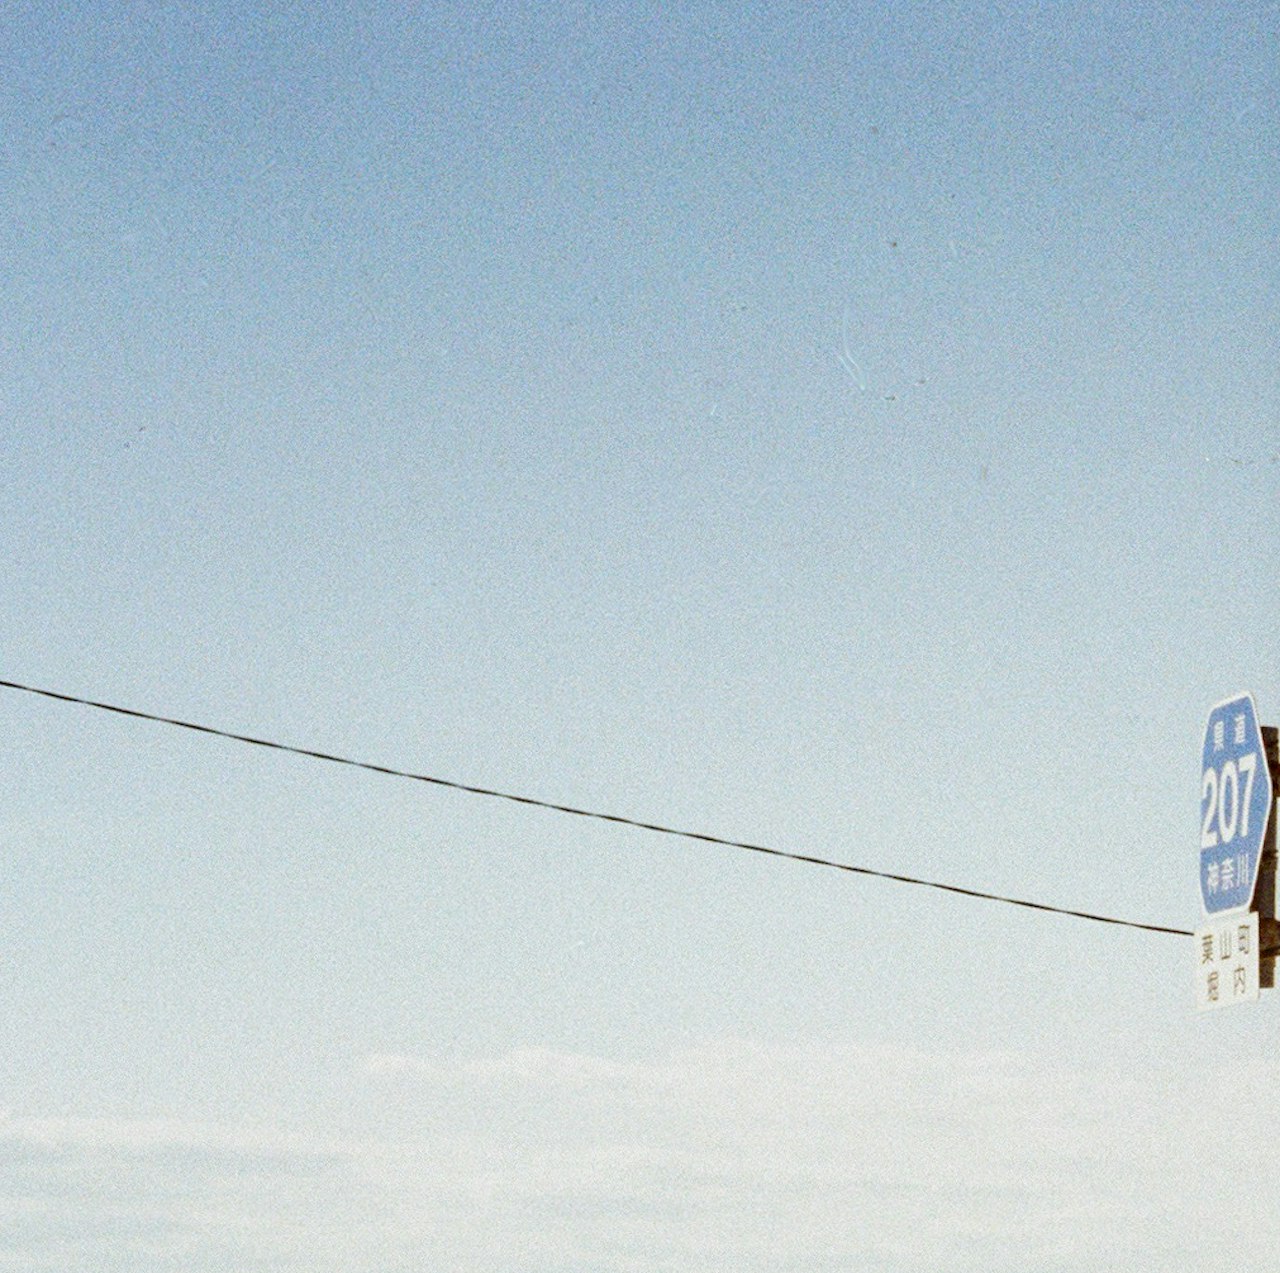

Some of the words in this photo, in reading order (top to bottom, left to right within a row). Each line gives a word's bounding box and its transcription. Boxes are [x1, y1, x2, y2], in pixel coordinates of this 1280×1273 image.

[1200, 752, 1258, 849] 207
[1206, 854, 1250, 897] 神奈川
